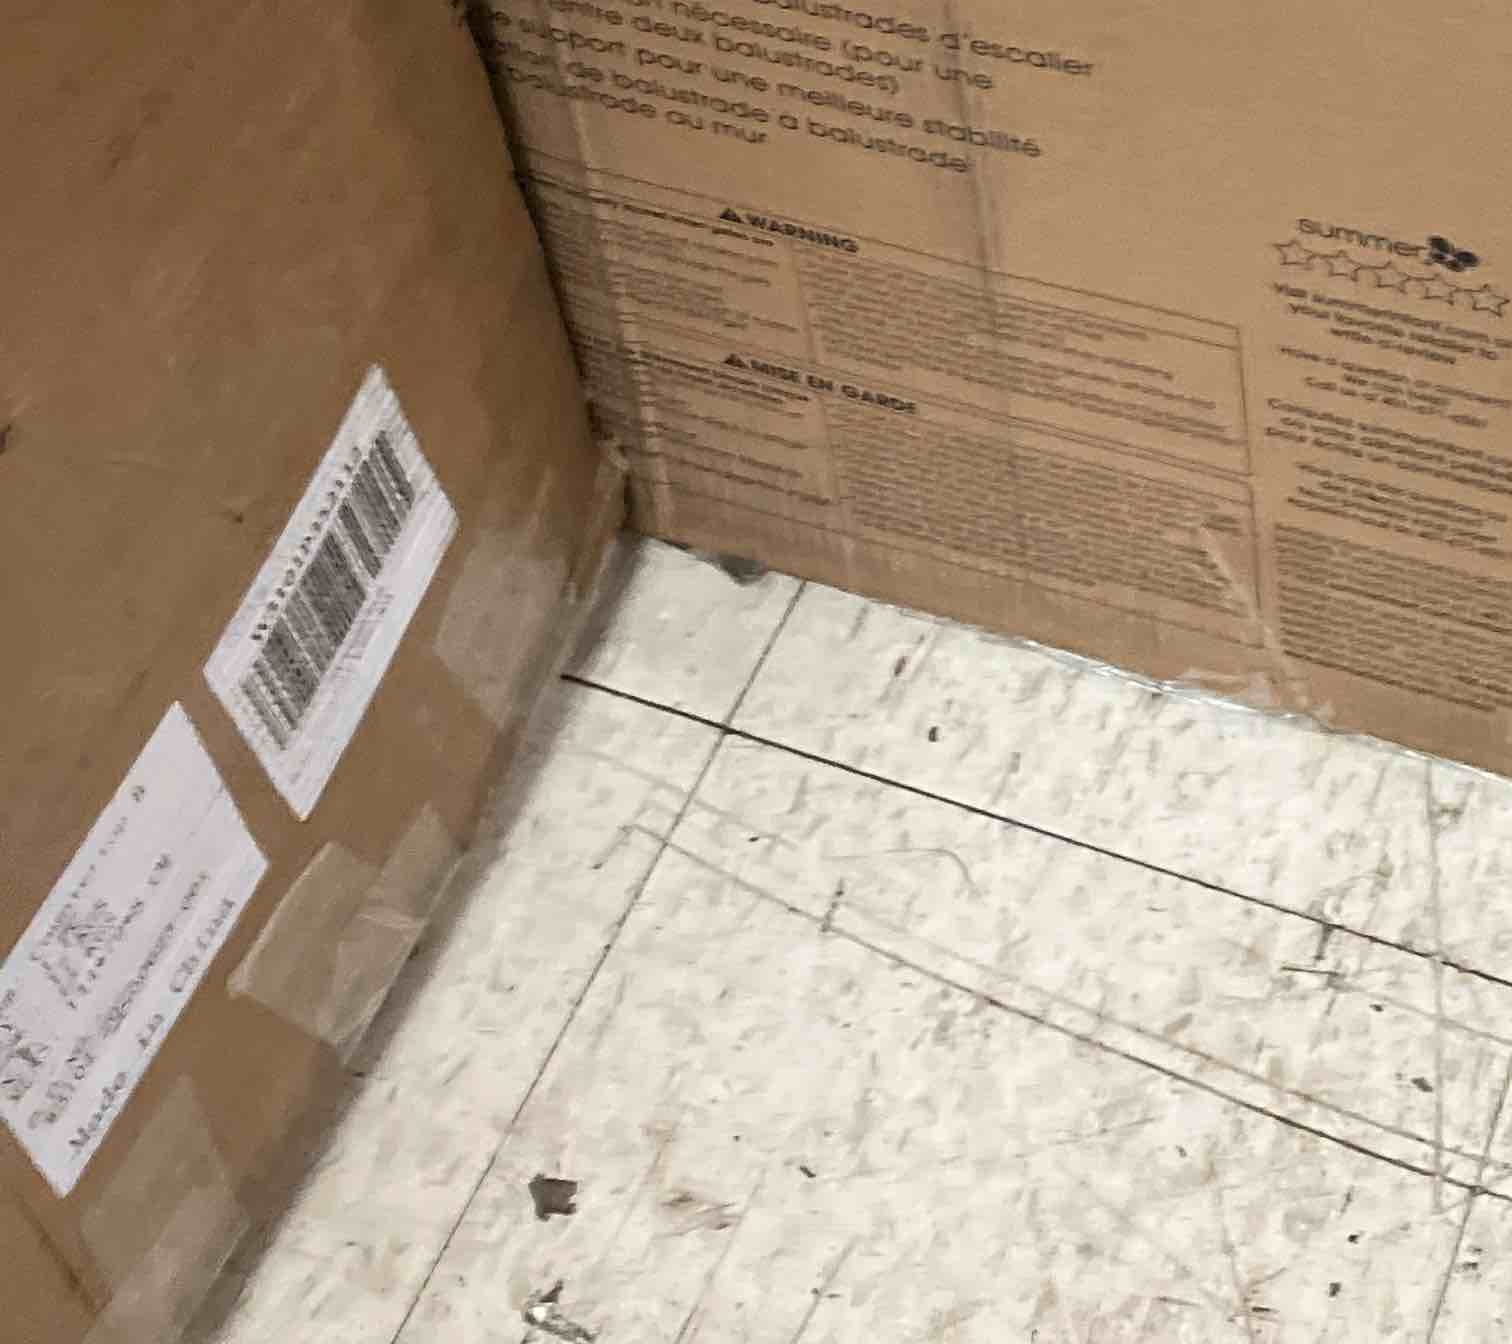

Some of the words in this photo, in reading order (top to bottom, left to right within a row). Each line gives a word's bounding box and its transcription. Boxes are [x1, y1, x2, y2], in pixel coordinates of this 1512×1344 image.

[630, 15, 705, 44] deux
[713, 34, 899, 95] balustrades)
[842, 39, 923, 73] (pour
[934, 64, 993, 90] une
[636, 48, 704, 75] pour
[712, 67, 769, 93] une
[776, 81, 914, 128] meilleure
[609, 69, 769, 124] balustrade
[807, 117, 969, 173] balustrade
[665, 111, 705, 130] au
[712, 121, 768, 144] mur
[748, 214, 859, 253] WARNING
